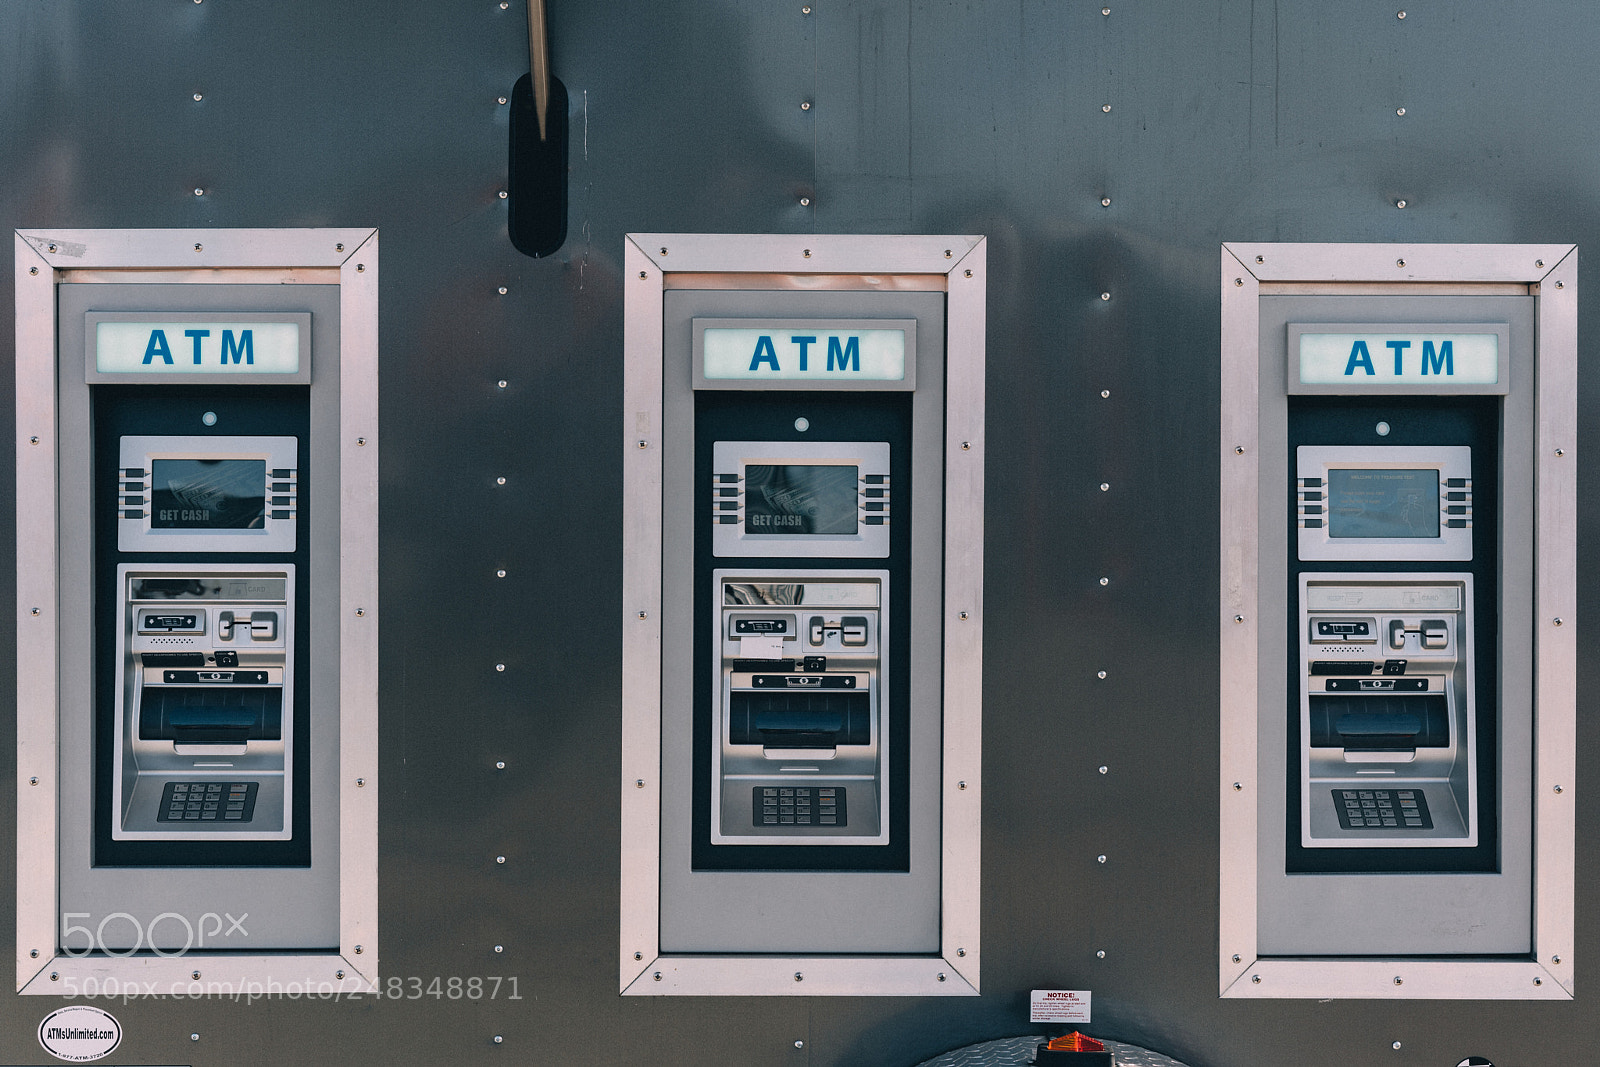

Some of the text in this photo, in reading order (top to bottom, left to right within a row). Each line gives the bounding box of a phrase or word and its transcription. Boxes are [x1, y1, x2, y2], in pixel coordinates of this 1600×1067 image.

[142, 329, 255, 365] ATM
[748, 335, 861, 371] ATM
[1344, 340, 1455, 376] ATM
[159, 509, 210, 520] GET CASH
[752, 515, 802, 526] GET CASH
[47, 1027, 114, 1040] ATMsUnlimited.com
